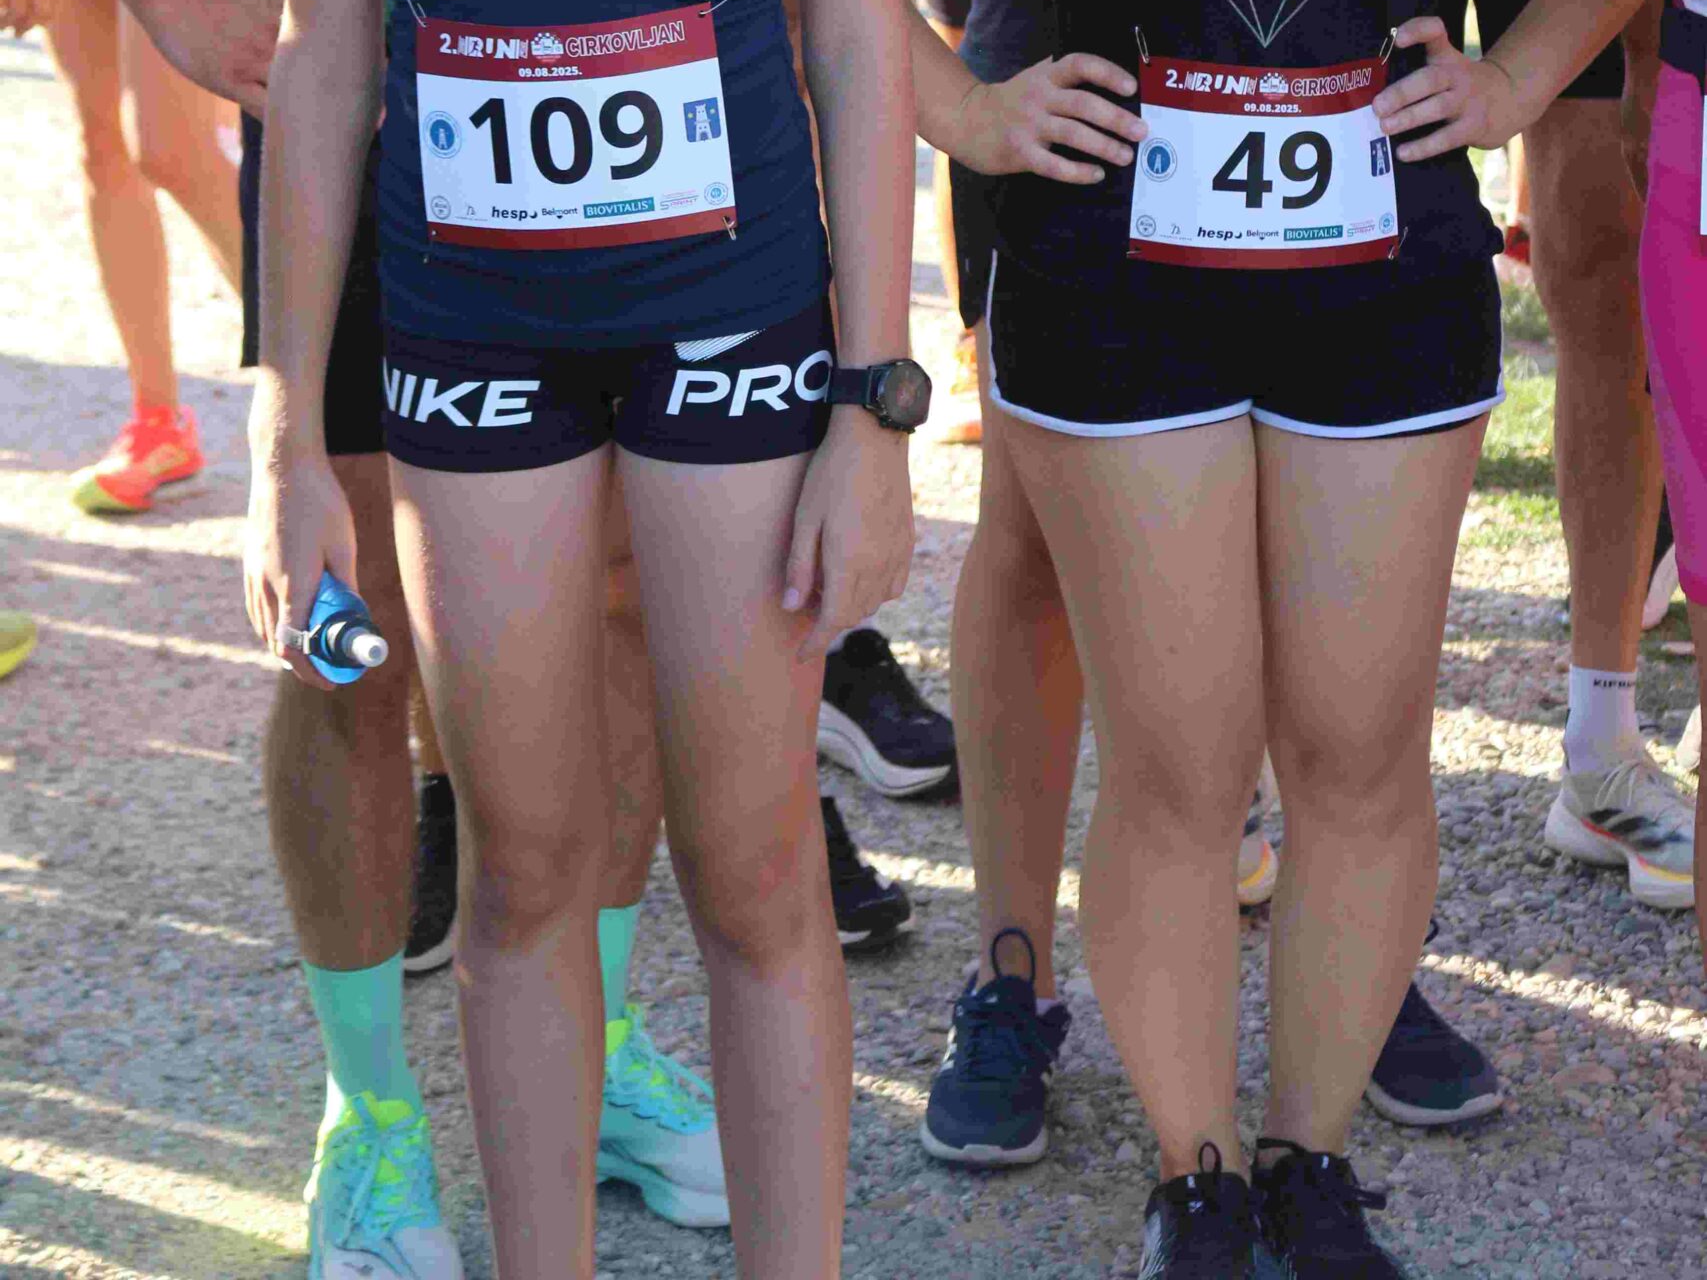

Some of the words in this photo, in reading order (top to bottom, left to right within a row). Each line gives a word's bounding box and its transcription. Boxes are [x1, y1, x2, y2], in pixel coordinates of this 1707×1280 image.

[565, 20, 686, 57] CIRKOVLJAN
[518, 65, 584, 78] 09.08.2025.
[1243, 102, 1302, 114] 09.08.2025.
[468, 89, 664, 186] 109
[1212, 130, 1333, 210] 49
[586, 199, 650, 217] BIOVITALIS
[1286, 228, 1339, 240] BIOVITALIS
[665, 349, 833, 417] PRO
